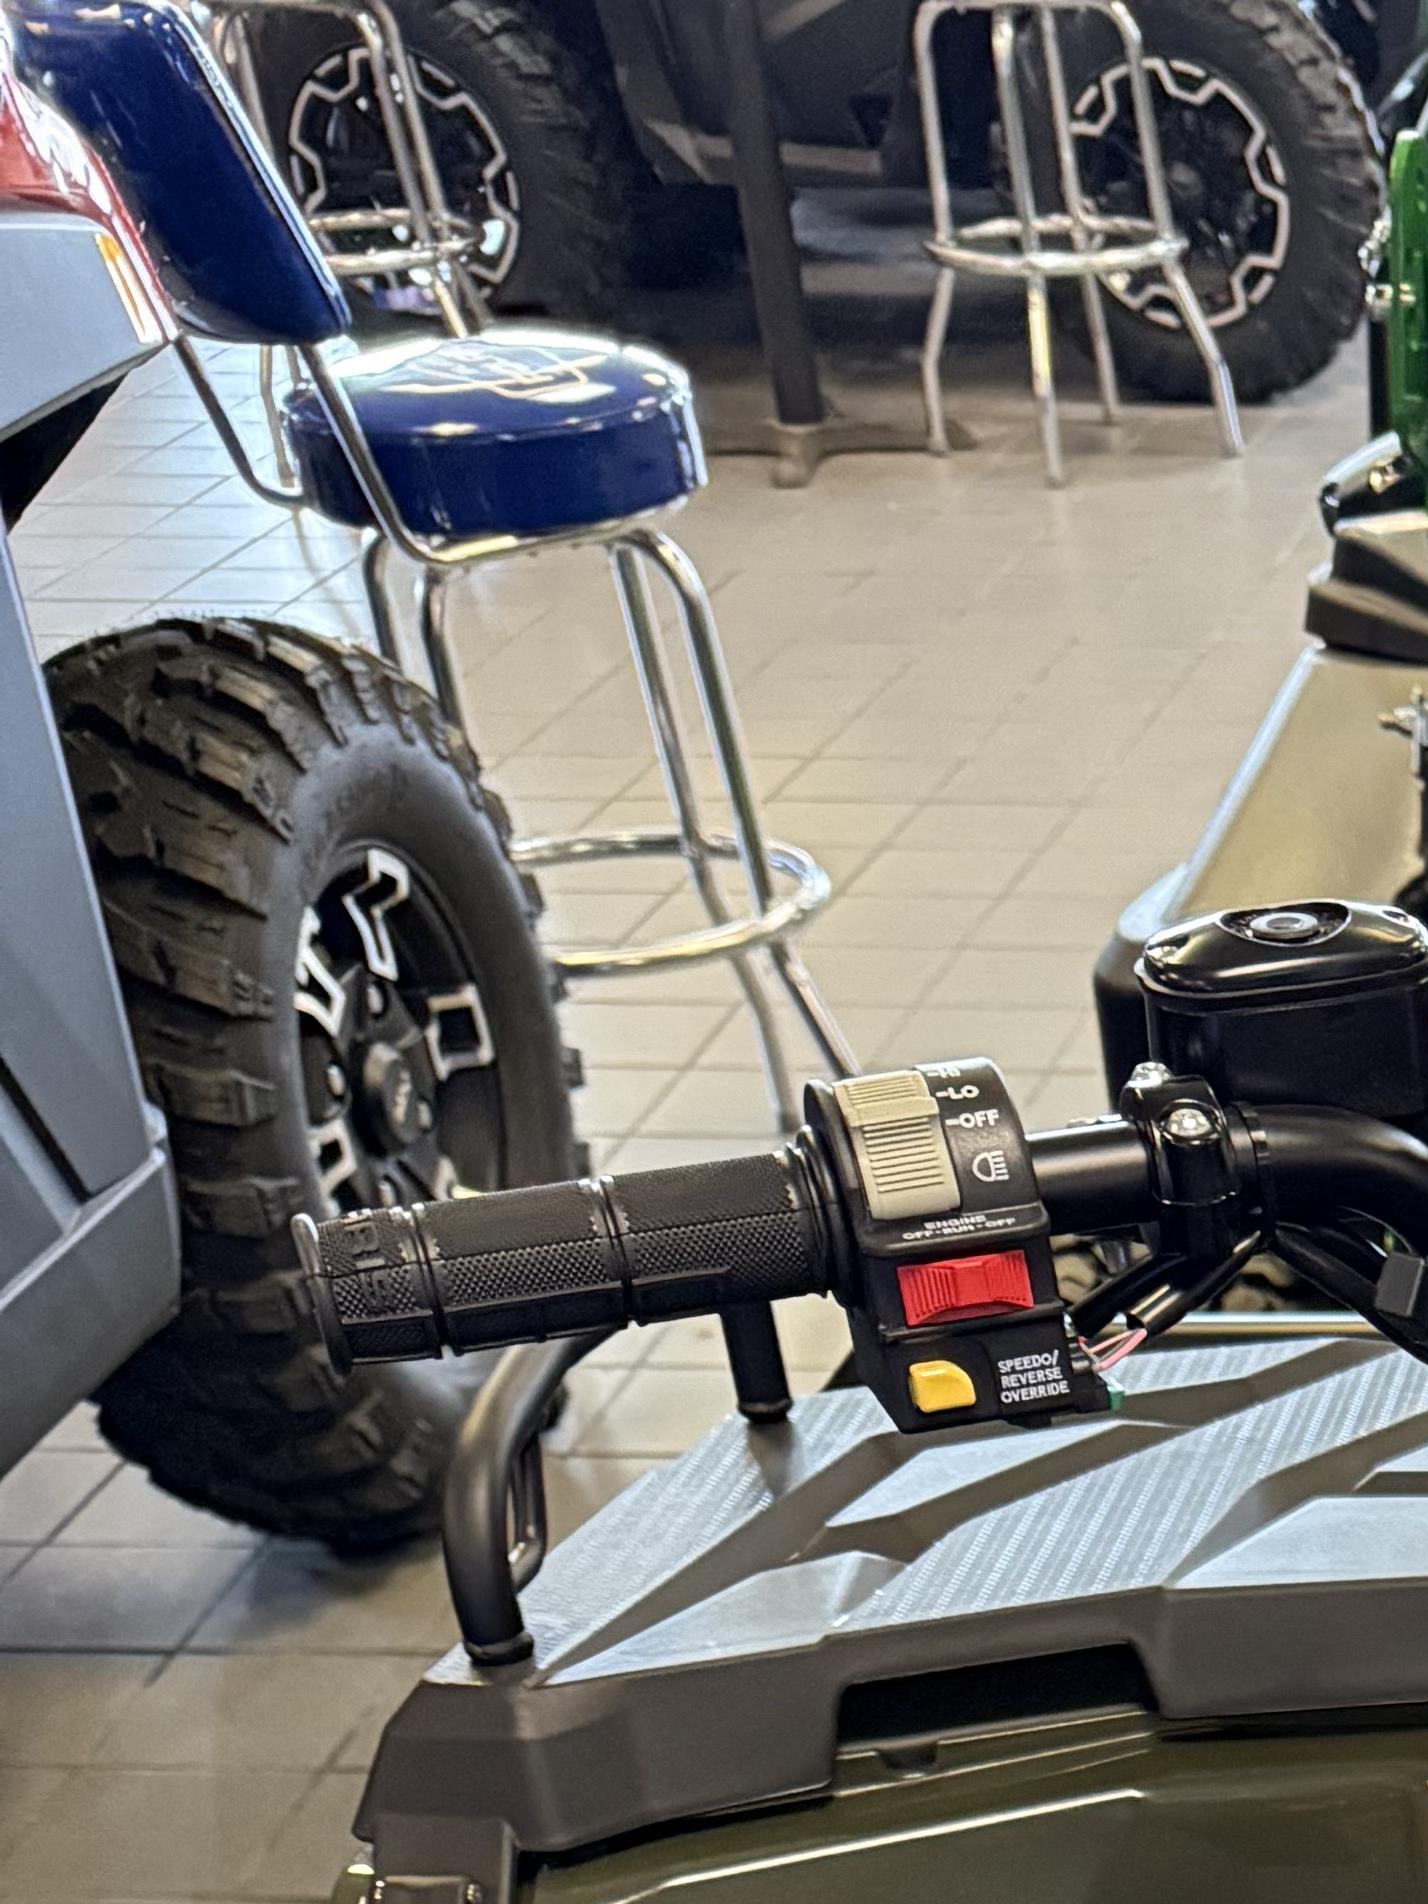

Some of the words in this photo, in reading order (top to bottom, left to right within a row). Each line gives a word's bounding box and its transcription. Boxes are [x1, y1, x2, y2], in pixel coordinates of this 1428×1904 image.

[947, 1084, 980, 1100] LO
[958, 1108, 1000, 1129] OFF
[923, 1214, 987, 1231] ENGINE
[998, 1348, 1060, 1374] SPEEDO/
[1001, 1366, 1064, 1390] REVERSE
[1001, 1380, 1071, 1404] OVERRIDE
